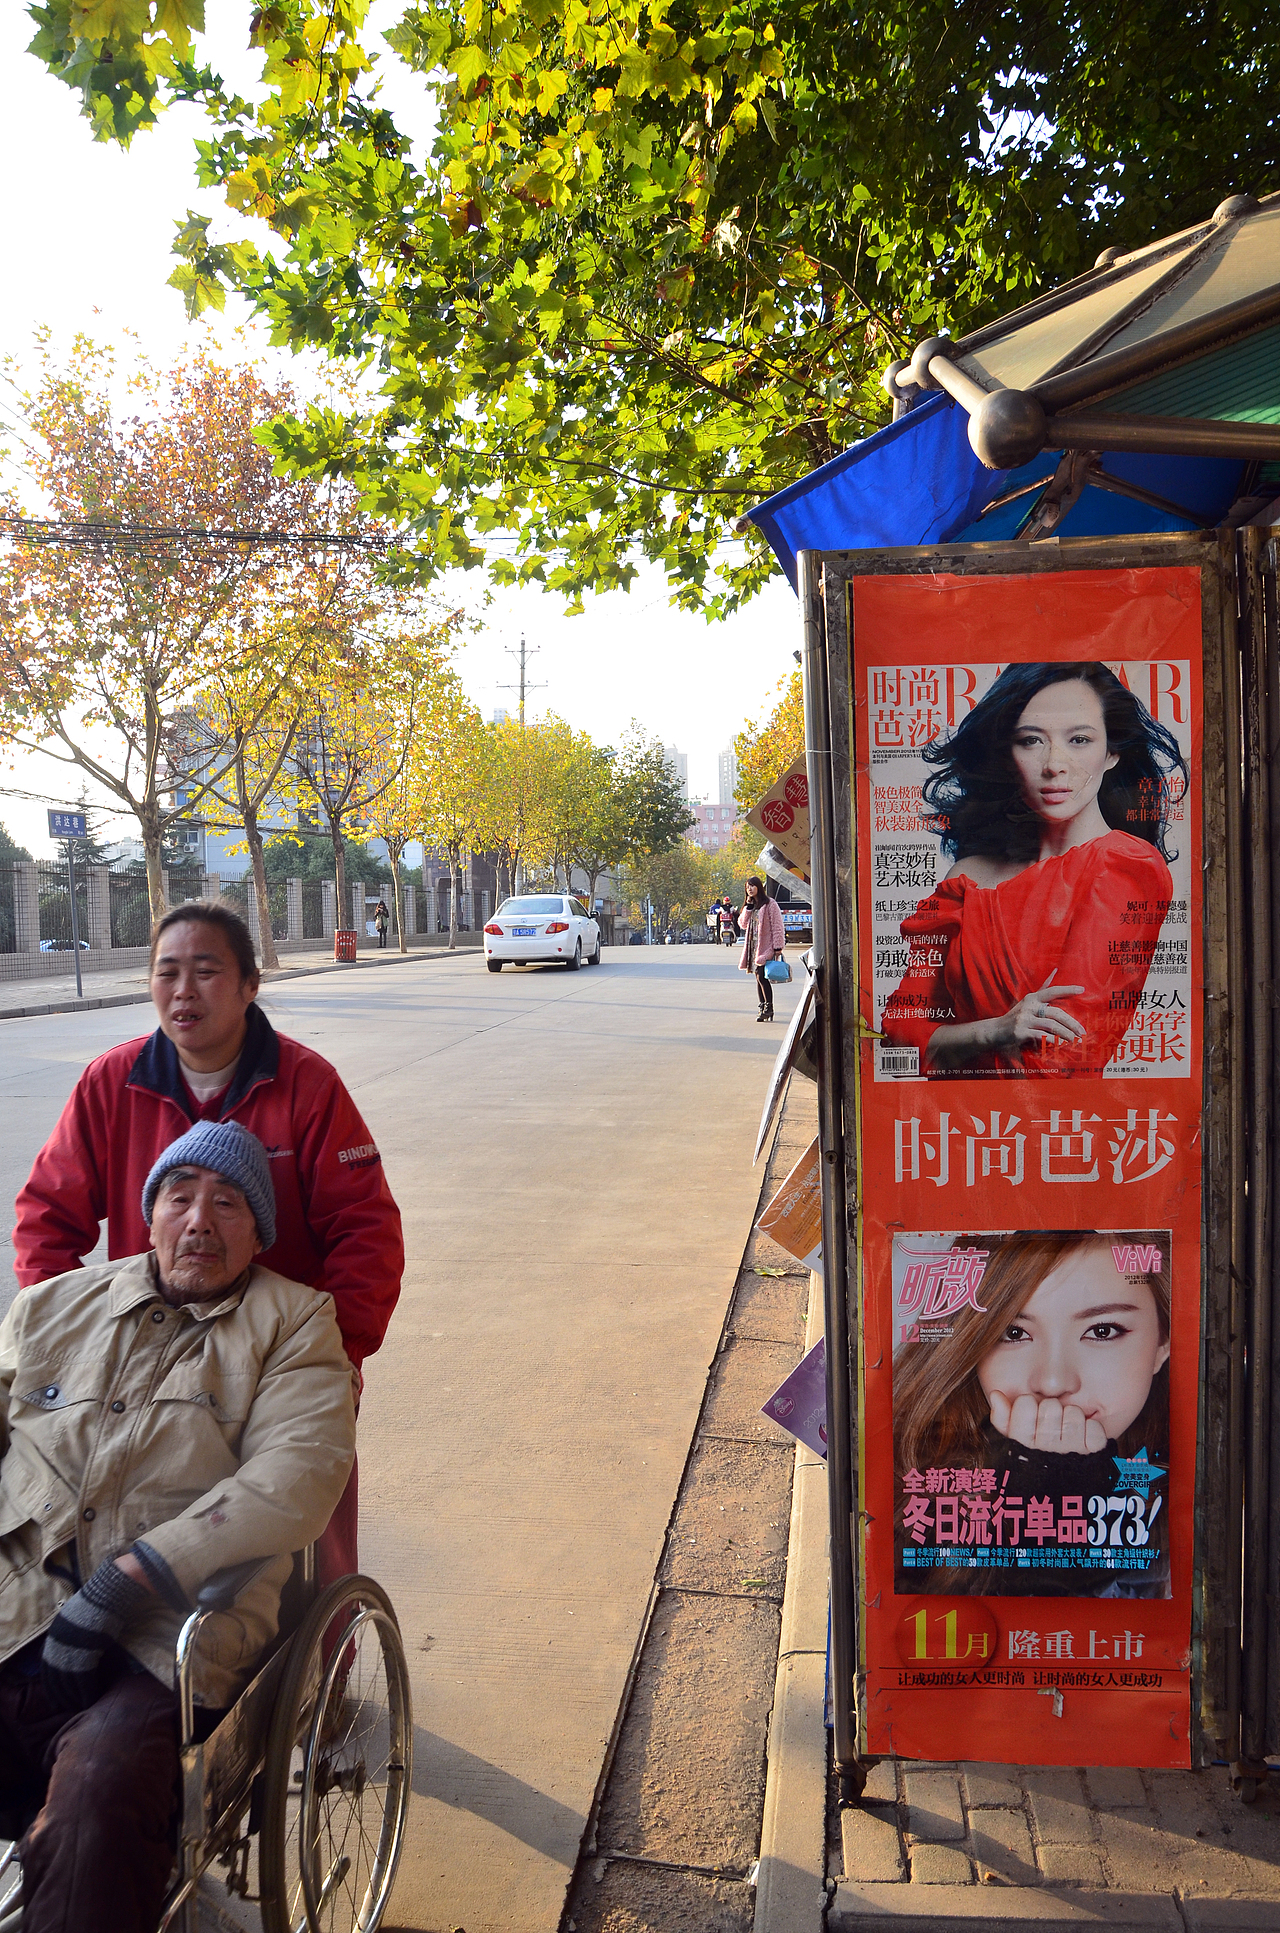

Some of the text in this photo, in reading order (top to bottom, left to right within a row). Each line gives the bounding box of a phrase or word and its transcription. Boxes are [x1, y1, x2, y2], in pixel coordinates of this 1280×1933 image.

[873, 667, 940, 707] 时尚
[869, 708, 942, 748] 芭莎
[874, 786, 922, 800] 极色极简
[1137, 776, 1185, 793] 章子怡
[874, 800, 923, 814] 智美双全
[874, 814, 952, 832] 秋装新形象
[874, 852, 938, 870] 真空妙有
[874, 870, 937, 888] 艺术妆容
[875, 900, 940, 912] 纸上珍宝之旅
[1120, 912, 1188, 925] 笑着迎接挑战
[1108, 939, 1188, 952] 让慈善影响中国
[875, 948, 944, 968] 勇敢添色
[1109, 952, 1188, 965] 芭莎明星慈善夜
[877, 993, 928, 1008] 让你成为
[1108, 989, 1187, 1010] 品牌女人
[883, 1007, 956, 1020] 无法拒绝的女人
[1086, 1010, 1187, 1032] 让你的名字
[1041, 1032, 1187, 1064] 比生命更长
[894, 1109, 1179, 1188] 时尚芭莎
[899, 1323, 920, 1343] 12
[916, 1558, 934, 1567] BEST
[935, 1558, 945, 1567] OF
[904, 1609, 989, 1660] 11月
[1008, 1629, 1146, 1661] 隆重上市
[898, 1671, 1163, 1688] 让成功的女人更时尚 让时尚的女人更成功
